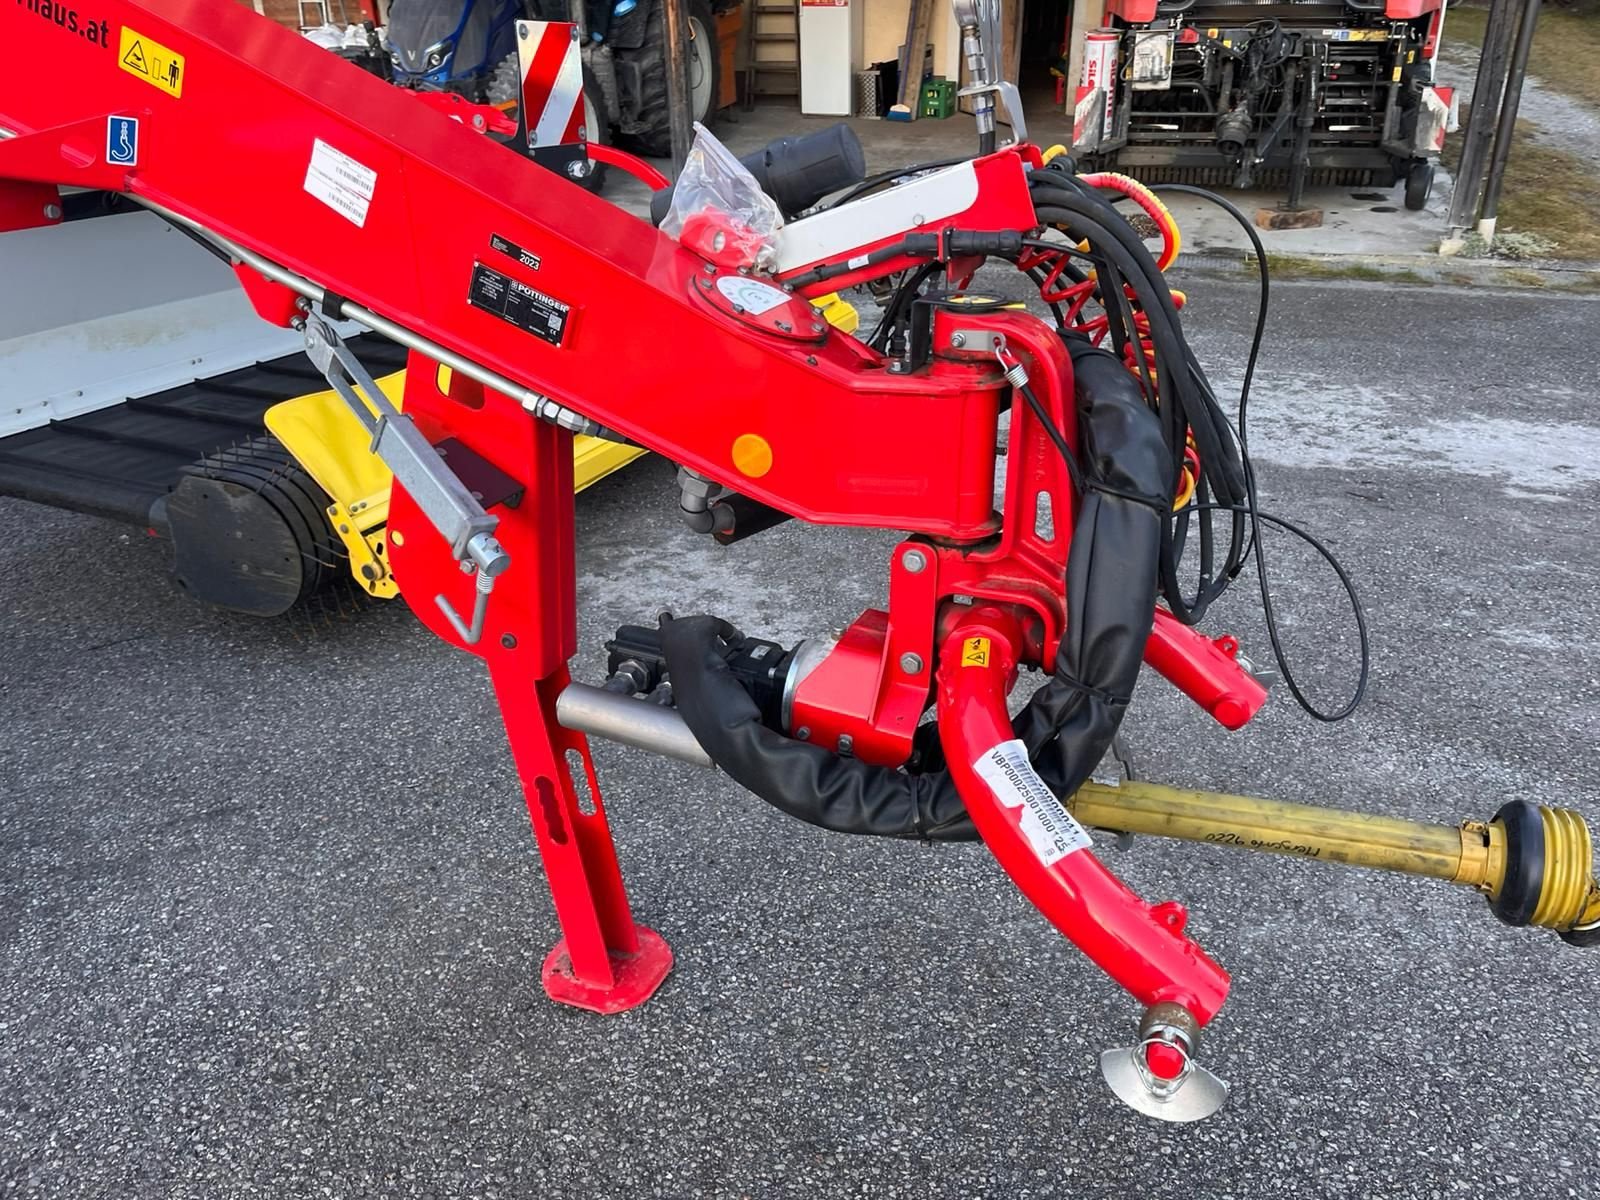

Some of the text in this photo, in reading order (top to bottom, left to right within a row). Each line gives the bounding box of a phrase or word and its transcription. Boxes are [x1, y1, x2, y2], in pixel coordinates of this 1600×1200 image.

[17, 0, 108, 48] aus.at
[519, 253, 540, 270] 2023
[1204, 832, 1245, 846] 9220
